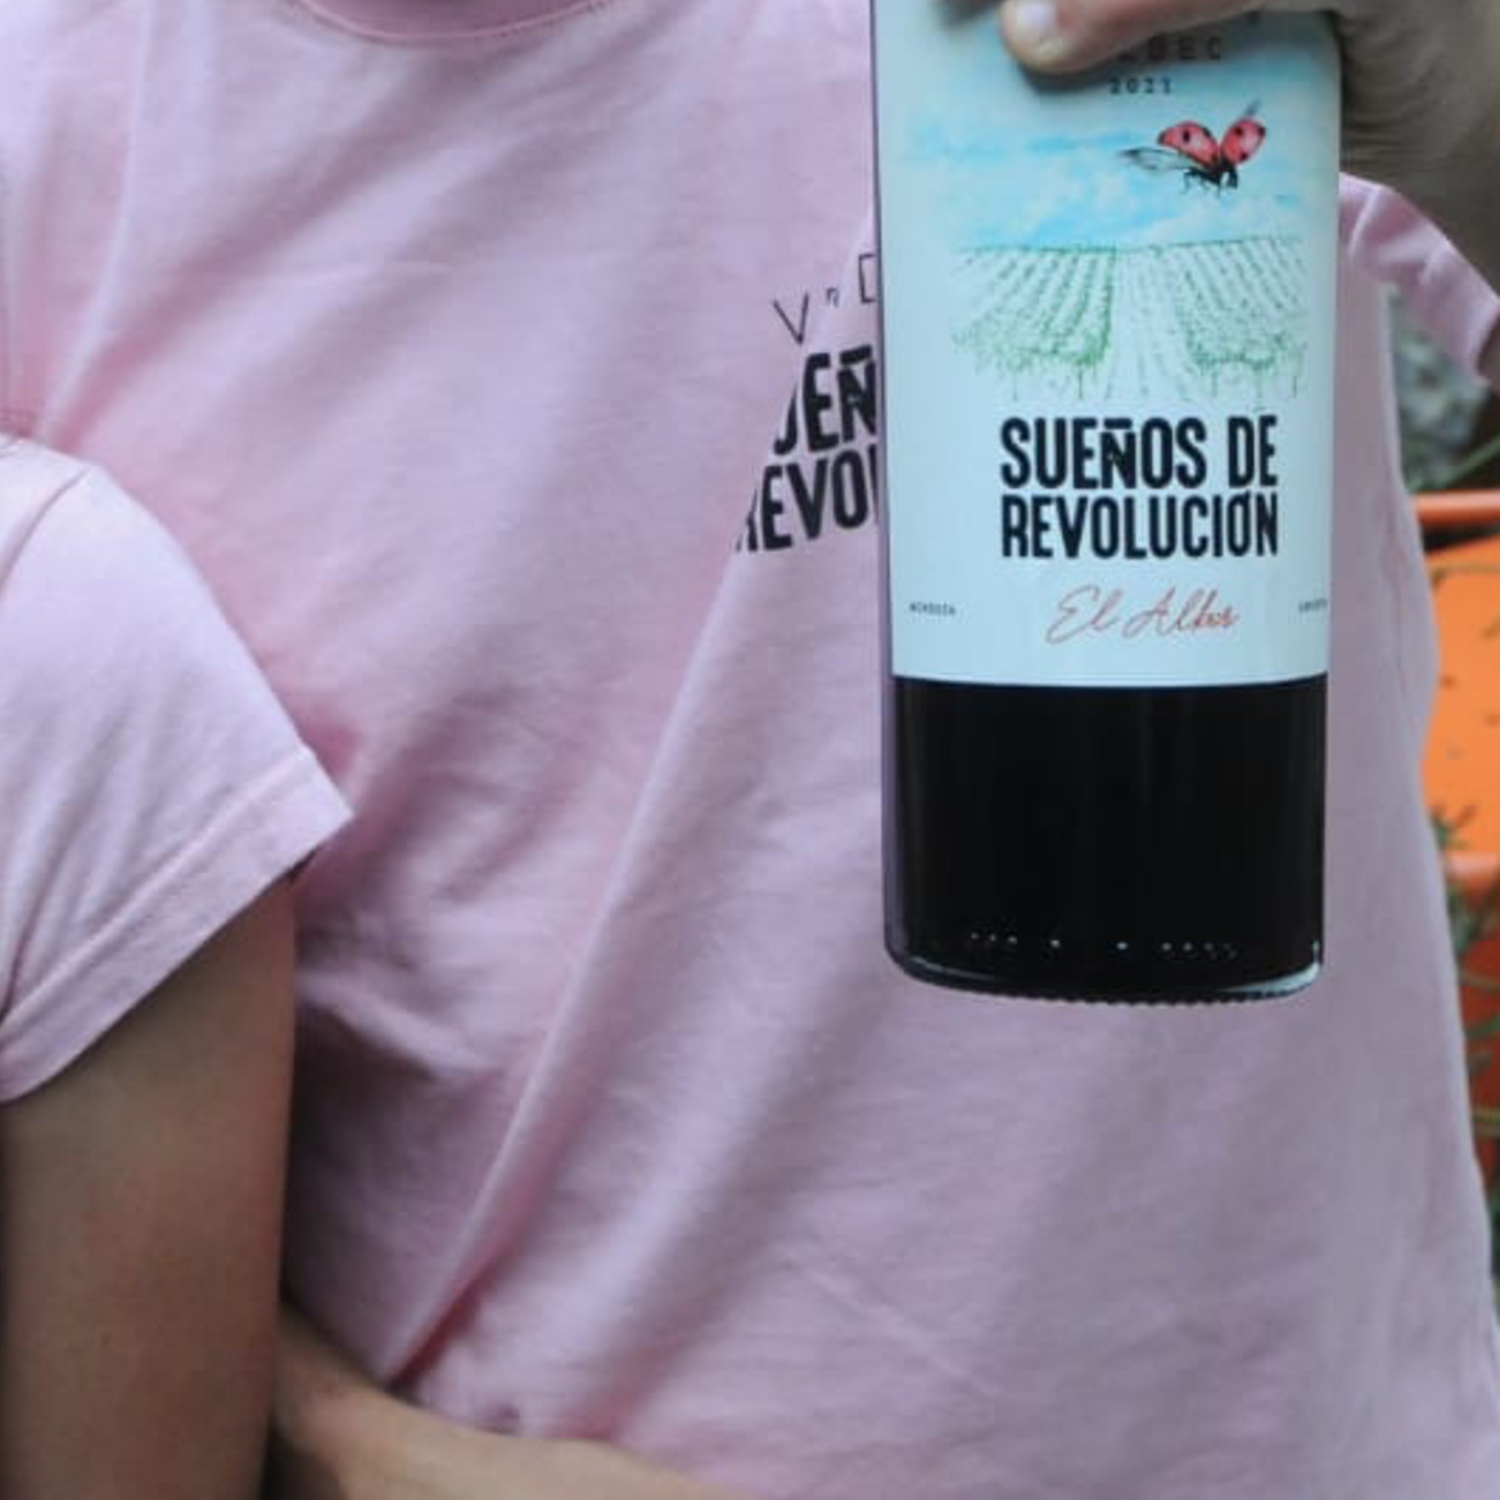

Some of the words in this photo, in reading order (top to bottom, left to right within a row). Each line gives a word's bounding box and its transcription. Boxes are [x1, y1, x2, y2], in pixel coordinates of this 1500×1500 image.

[1109, 76, 1173, 95] 2021
[1001, 417, 1206, 490] SUEÑOS
[1228, 414, 1279, 488] DE
[737, 443, 878, 552] EVO
[1001, 490, 1279, 560] REVOLUCIÓN
[1045, 583, 1124, 645] El
